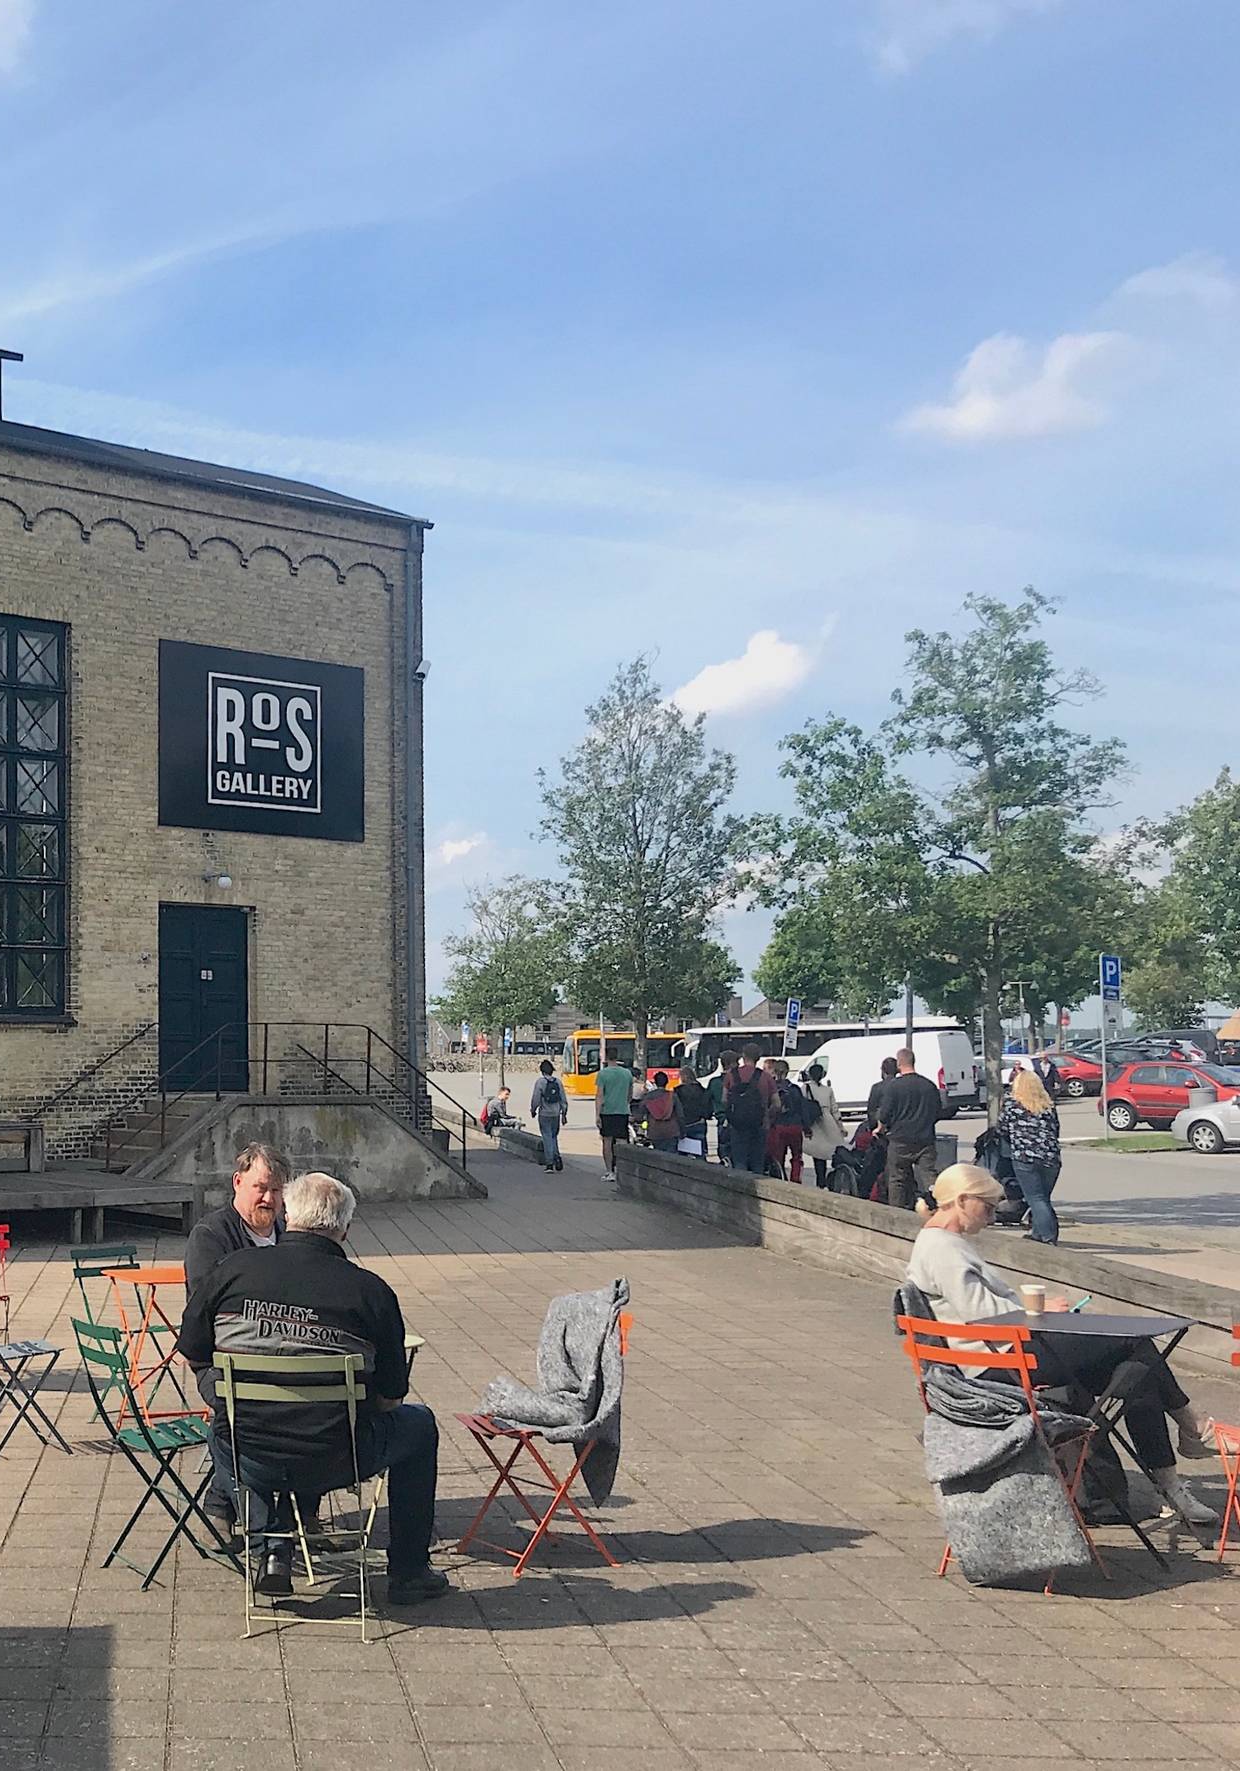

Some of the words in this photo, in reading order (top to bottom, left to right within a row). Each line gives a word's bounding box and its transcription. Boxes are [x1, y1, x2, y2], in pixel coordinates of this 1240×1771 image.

[216, 769, 313, 800] GALLERY
[1105, 960, 1117, 982] P
[790, 1002, 798, 1018] P
[258, 1318, 342, 1343] DAVIDSON
